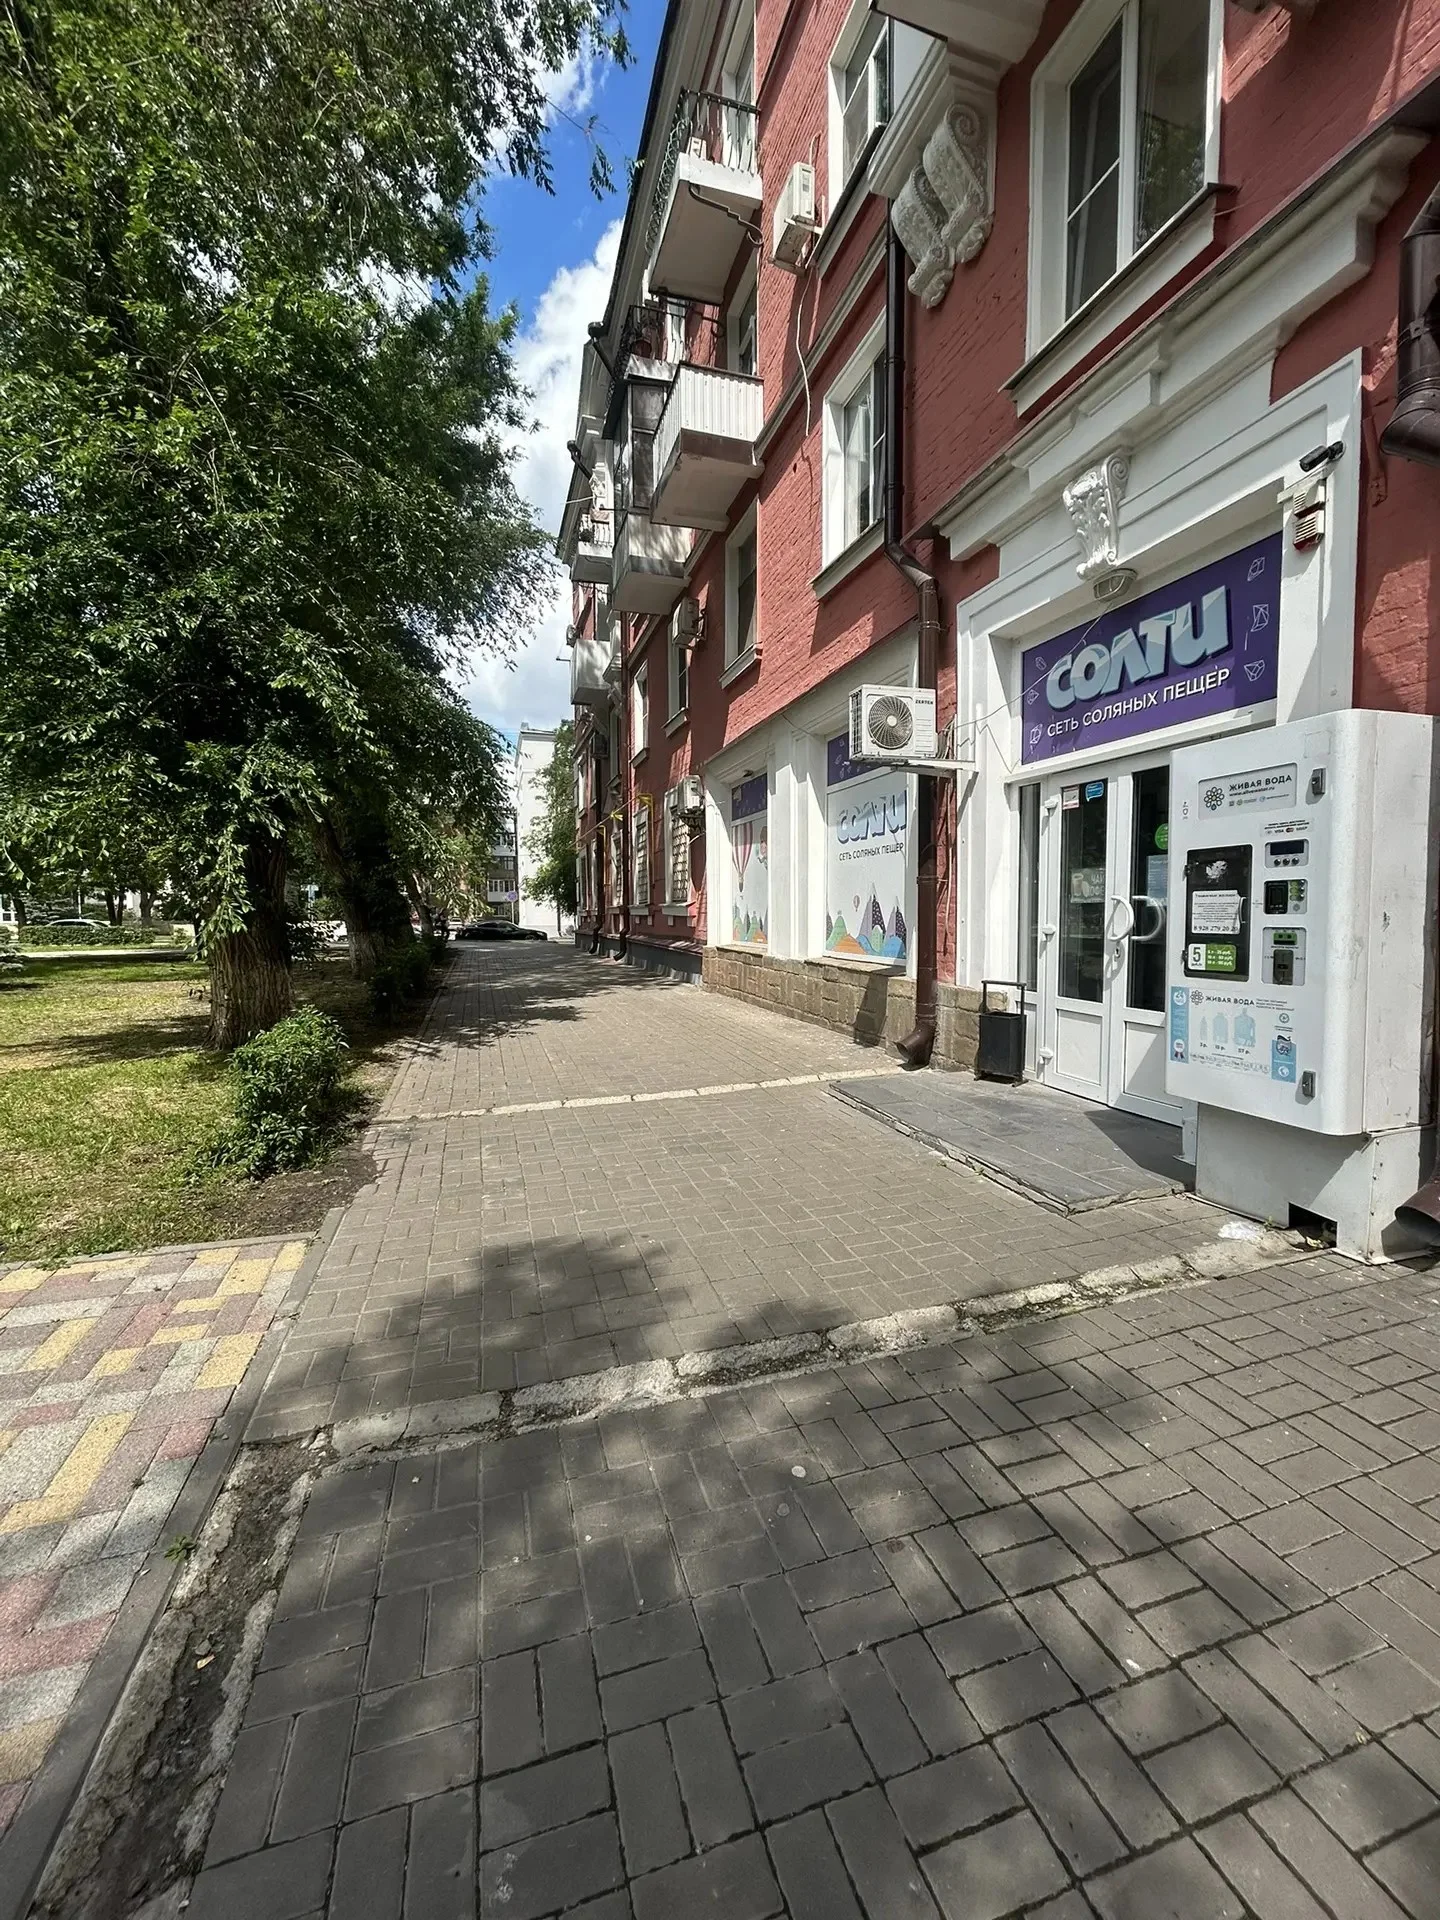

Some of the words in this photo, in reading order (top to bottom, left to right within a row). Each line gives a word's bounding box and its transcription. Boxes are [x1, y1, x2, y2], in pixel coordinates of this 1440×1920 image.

[1046, 585, 1232, 711] СОЛТИ
[1047, 718, 1079, 737] СЕТЬ
[1082, 692, 1159, 726] СОЛЯНЫХ
[1163, 668, 1230, 702] ПЕЩЕР
[1229, 780, 1262, 792] ЖИВАЯ
[1265, 774, 1292, 786] ВОДА
[839, 850, 852, 862] СЕТЬ
[853, 847, 880, 860] СОЛЯНЫХ
[881, 843, 905, 856] ПЕЩЕР
[1193, 947, 1201, 962] 5
[1205, 995, 1232, 1004] ЖИВАЯ
[1233, 998, 1254, 1006] ВОДА
